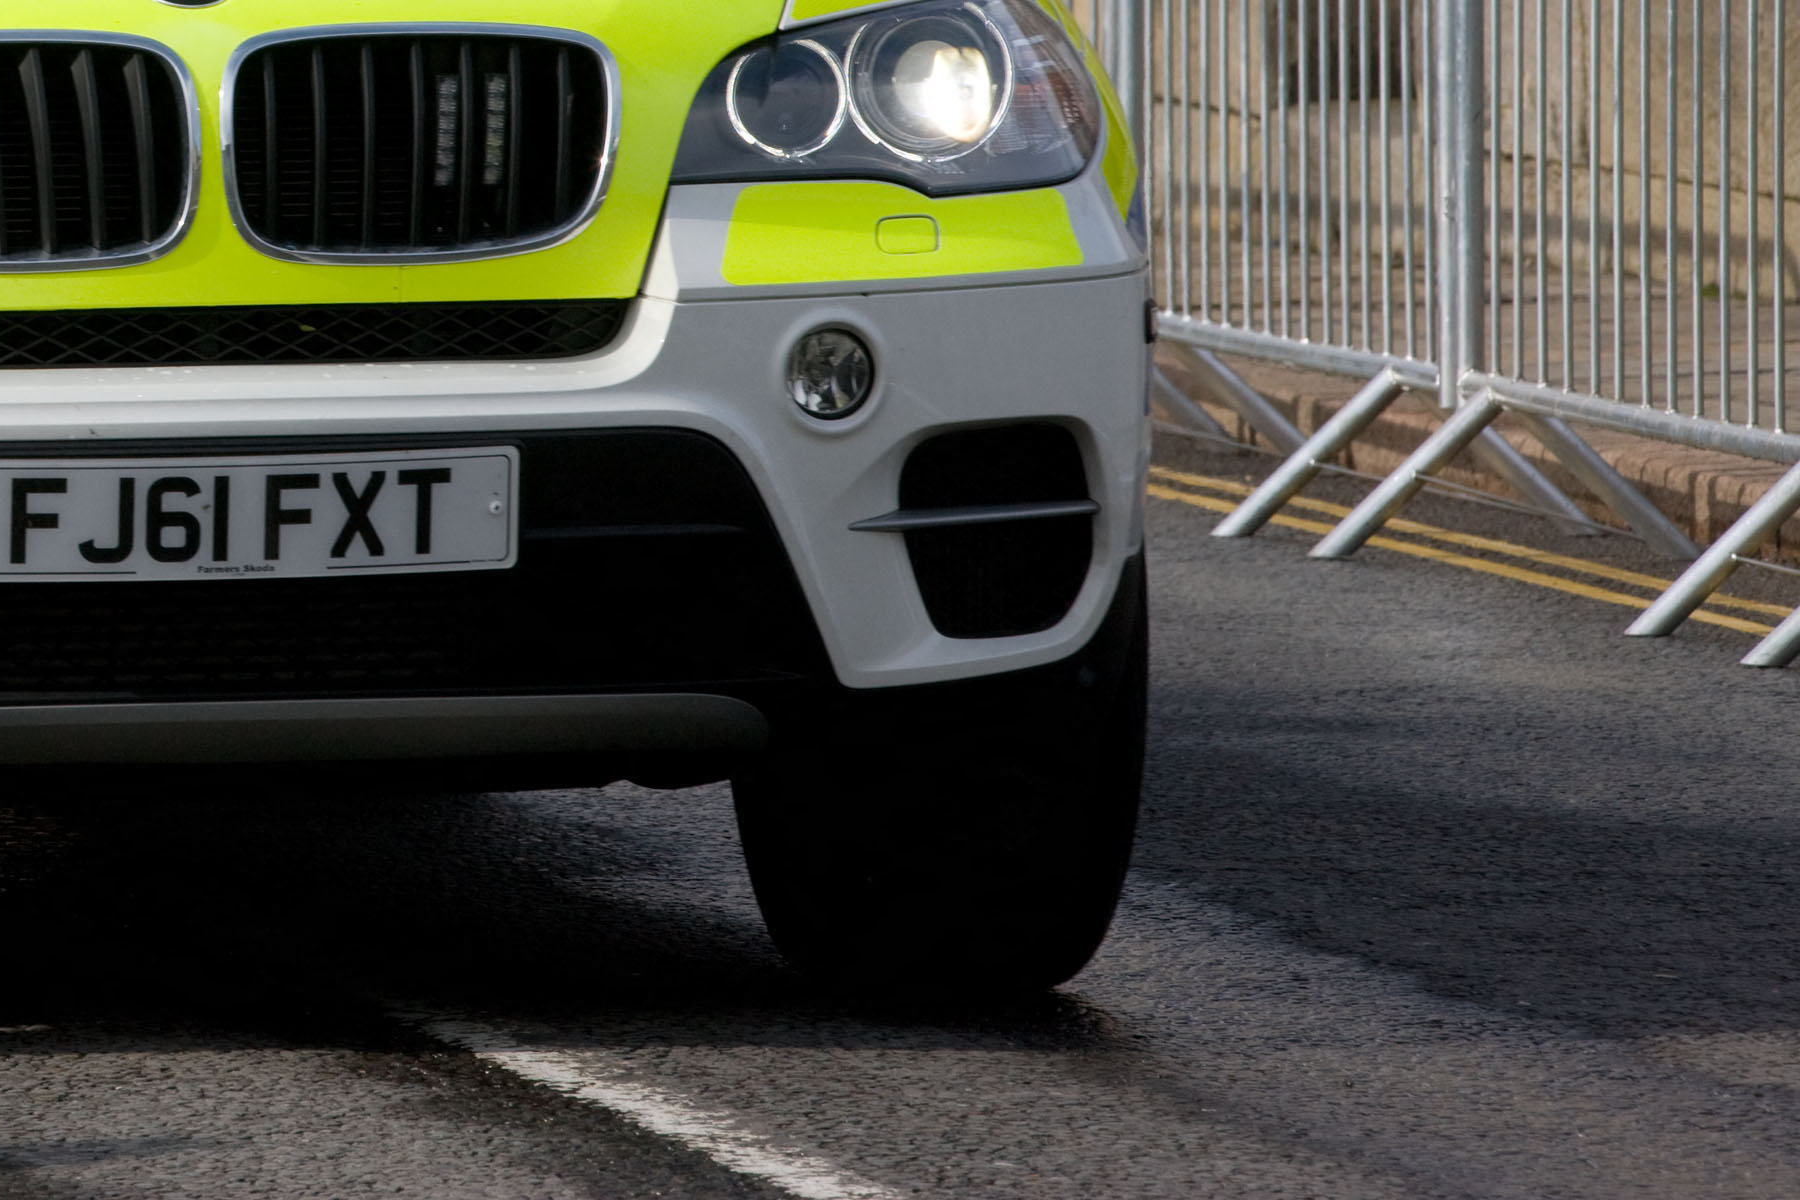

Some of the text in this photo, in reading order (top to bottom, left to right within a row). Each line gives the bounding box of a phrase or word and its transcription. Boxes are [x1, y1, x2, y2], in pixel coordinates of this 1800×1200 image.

[10, 467, 452, 565] FJ61 FXT
[243, 564, 276, 573] Skoda
